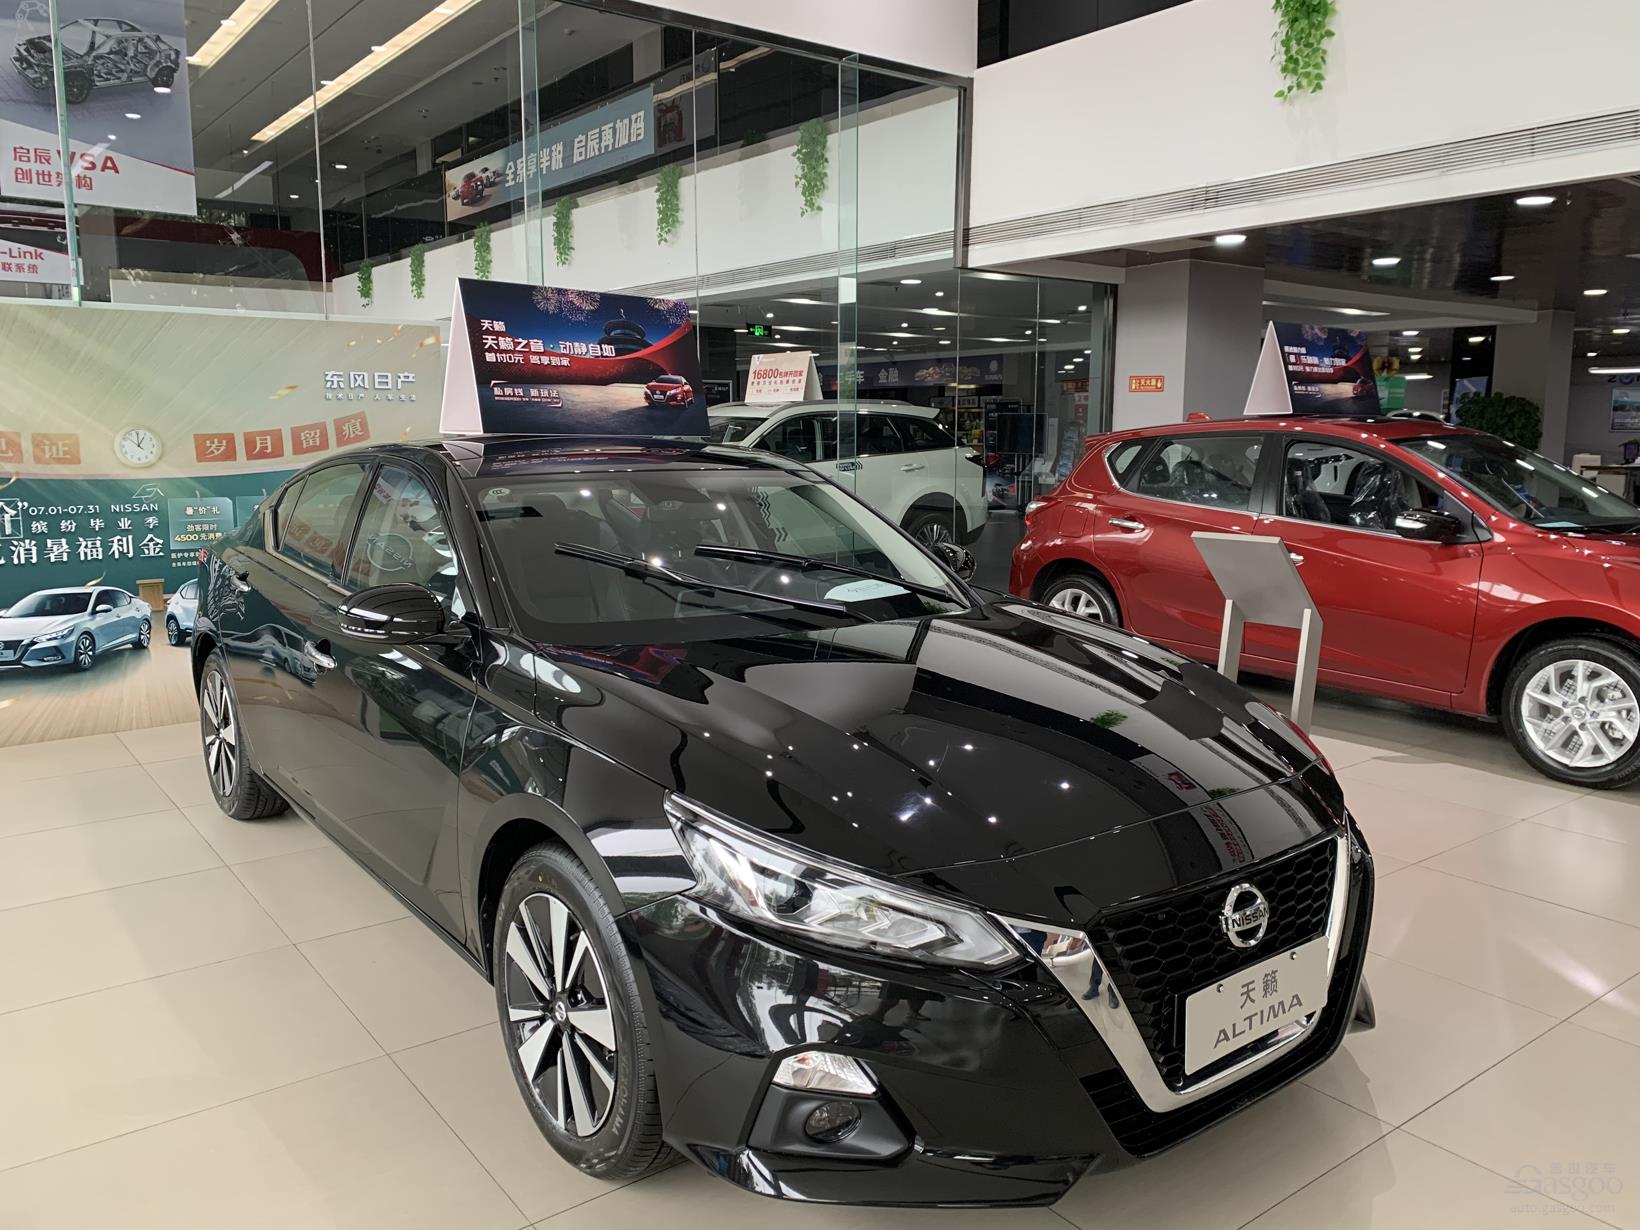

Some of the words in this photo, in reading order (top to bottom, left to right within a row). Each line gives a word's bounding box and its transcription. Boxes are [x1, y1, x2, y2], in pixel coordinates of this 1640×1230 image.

[573, 110, 645, 164] 启辰再加码
[13, 146, 52, 165] 启辰
[481, 319, 506, 332] 天籁
[325, 371, 416, 389] 东风日产
[206, 419, 365, 459] 岁月留痕
[29, 504, 100, 516] 07.01-07.31
[111, 503, 158, 513] NISSAN
[31, 516, 159, 534] 缤纷毕业季
[175, 533, 199, 542] 4500
[1231, 907, 1270, 929] NISSAN
[1240, 969, 1279, 1009] 天籁
[1214, 993, 1304, 1049] ALTIMA
